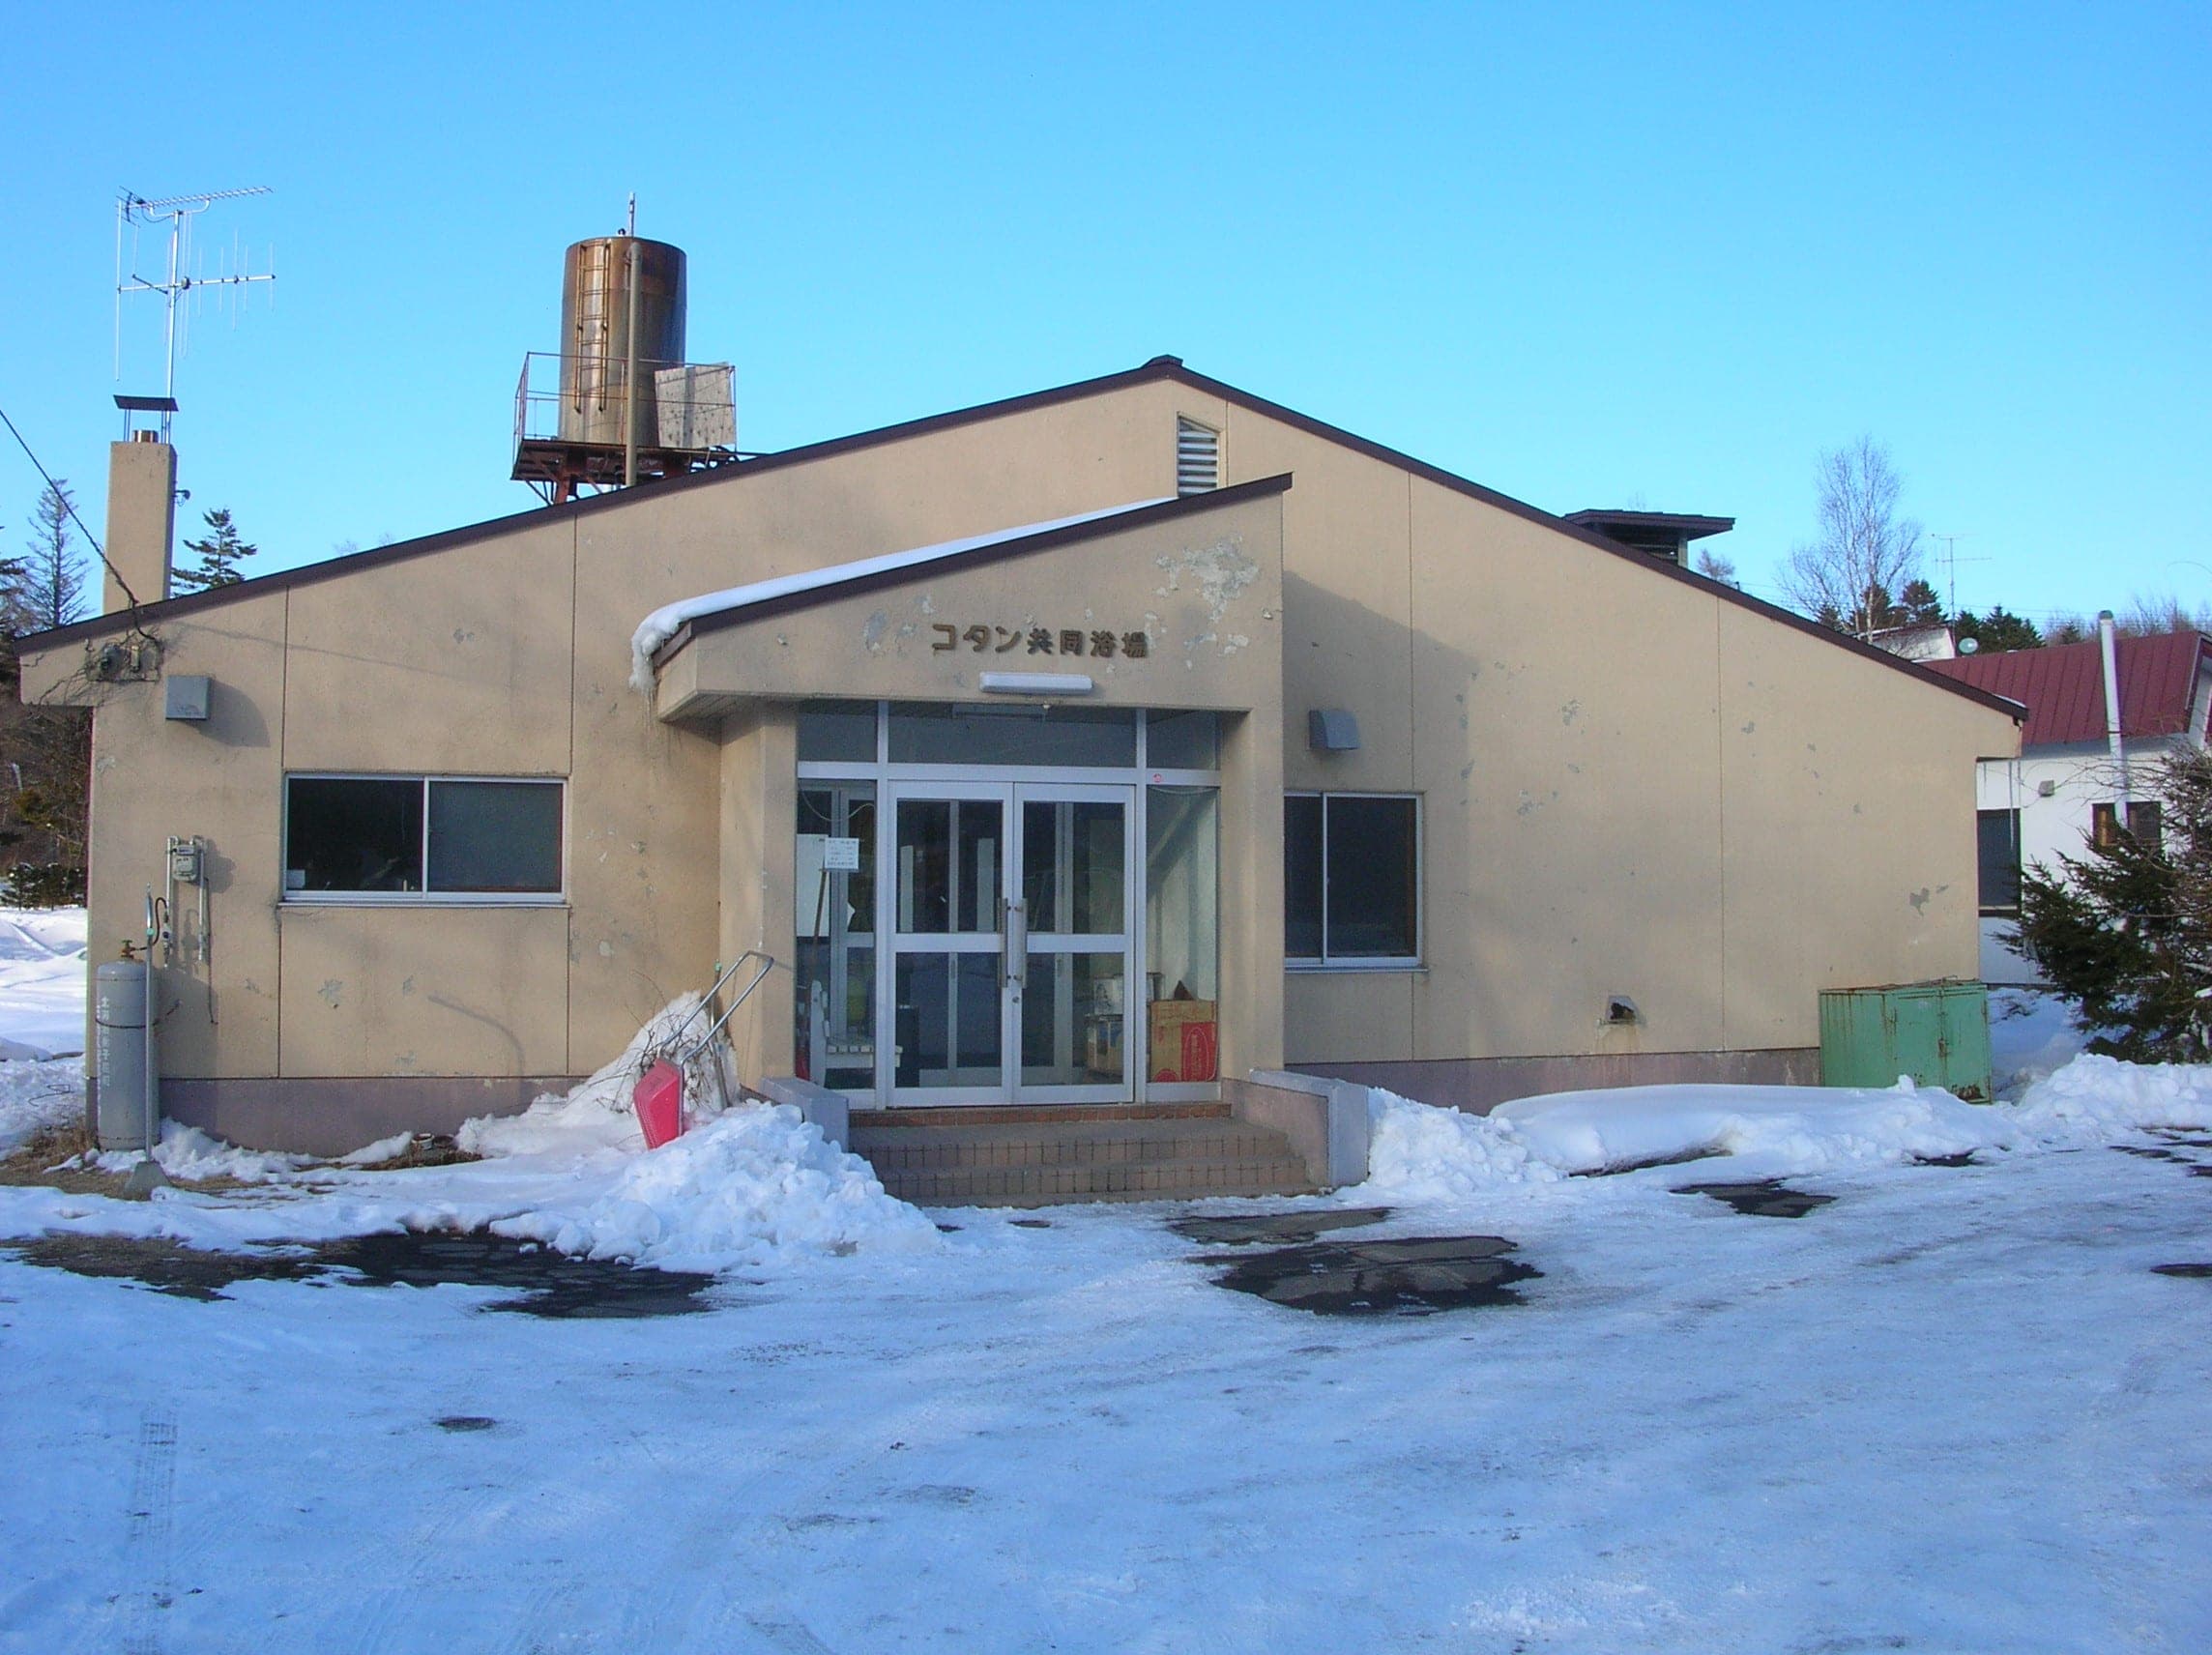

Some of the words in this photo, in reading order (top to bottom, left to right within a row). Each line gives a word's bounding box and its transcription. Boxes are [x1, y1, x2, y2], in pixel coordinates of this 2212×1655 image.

[932, 624, 1147, 658] コタン共同浴場
